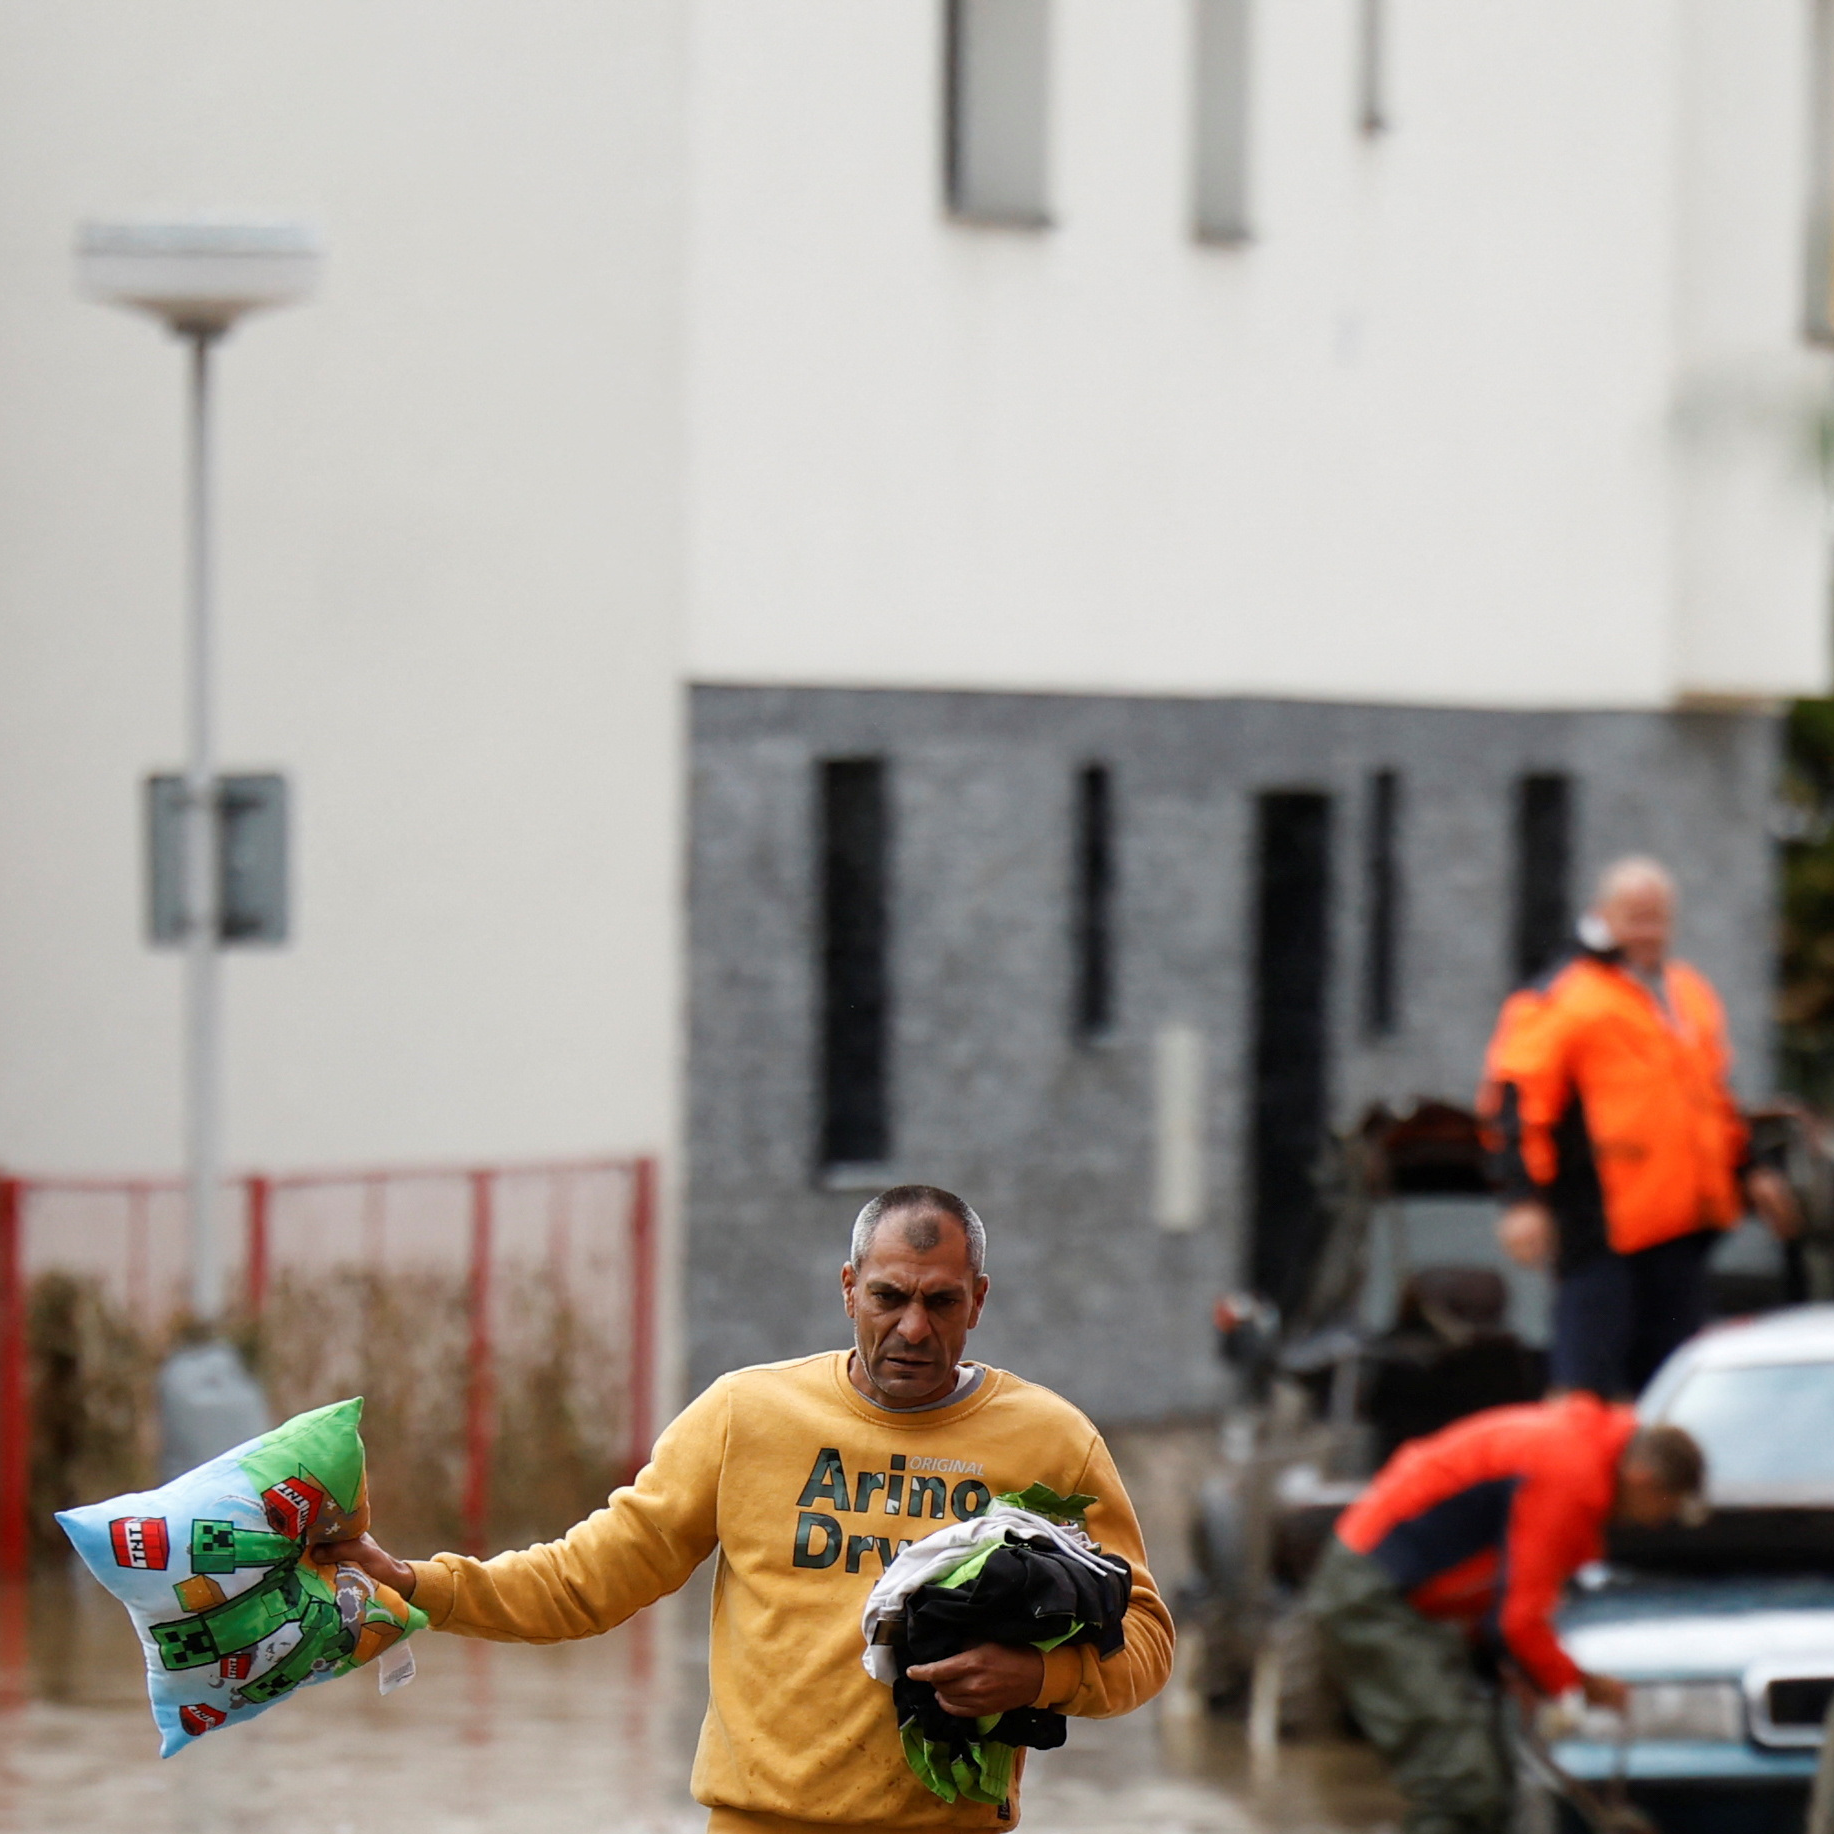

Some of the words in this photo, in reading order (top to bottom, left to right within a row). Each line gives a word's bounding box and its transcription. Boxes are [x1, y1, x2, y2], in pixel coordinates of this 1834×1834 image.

[909, 1456, 985, 1477] ORIGINAL
[277, 1486, 306, 1506] TNT
[795, 1447, 991, 1522] Arino
[128, 1527, 147, 1563] TNT
